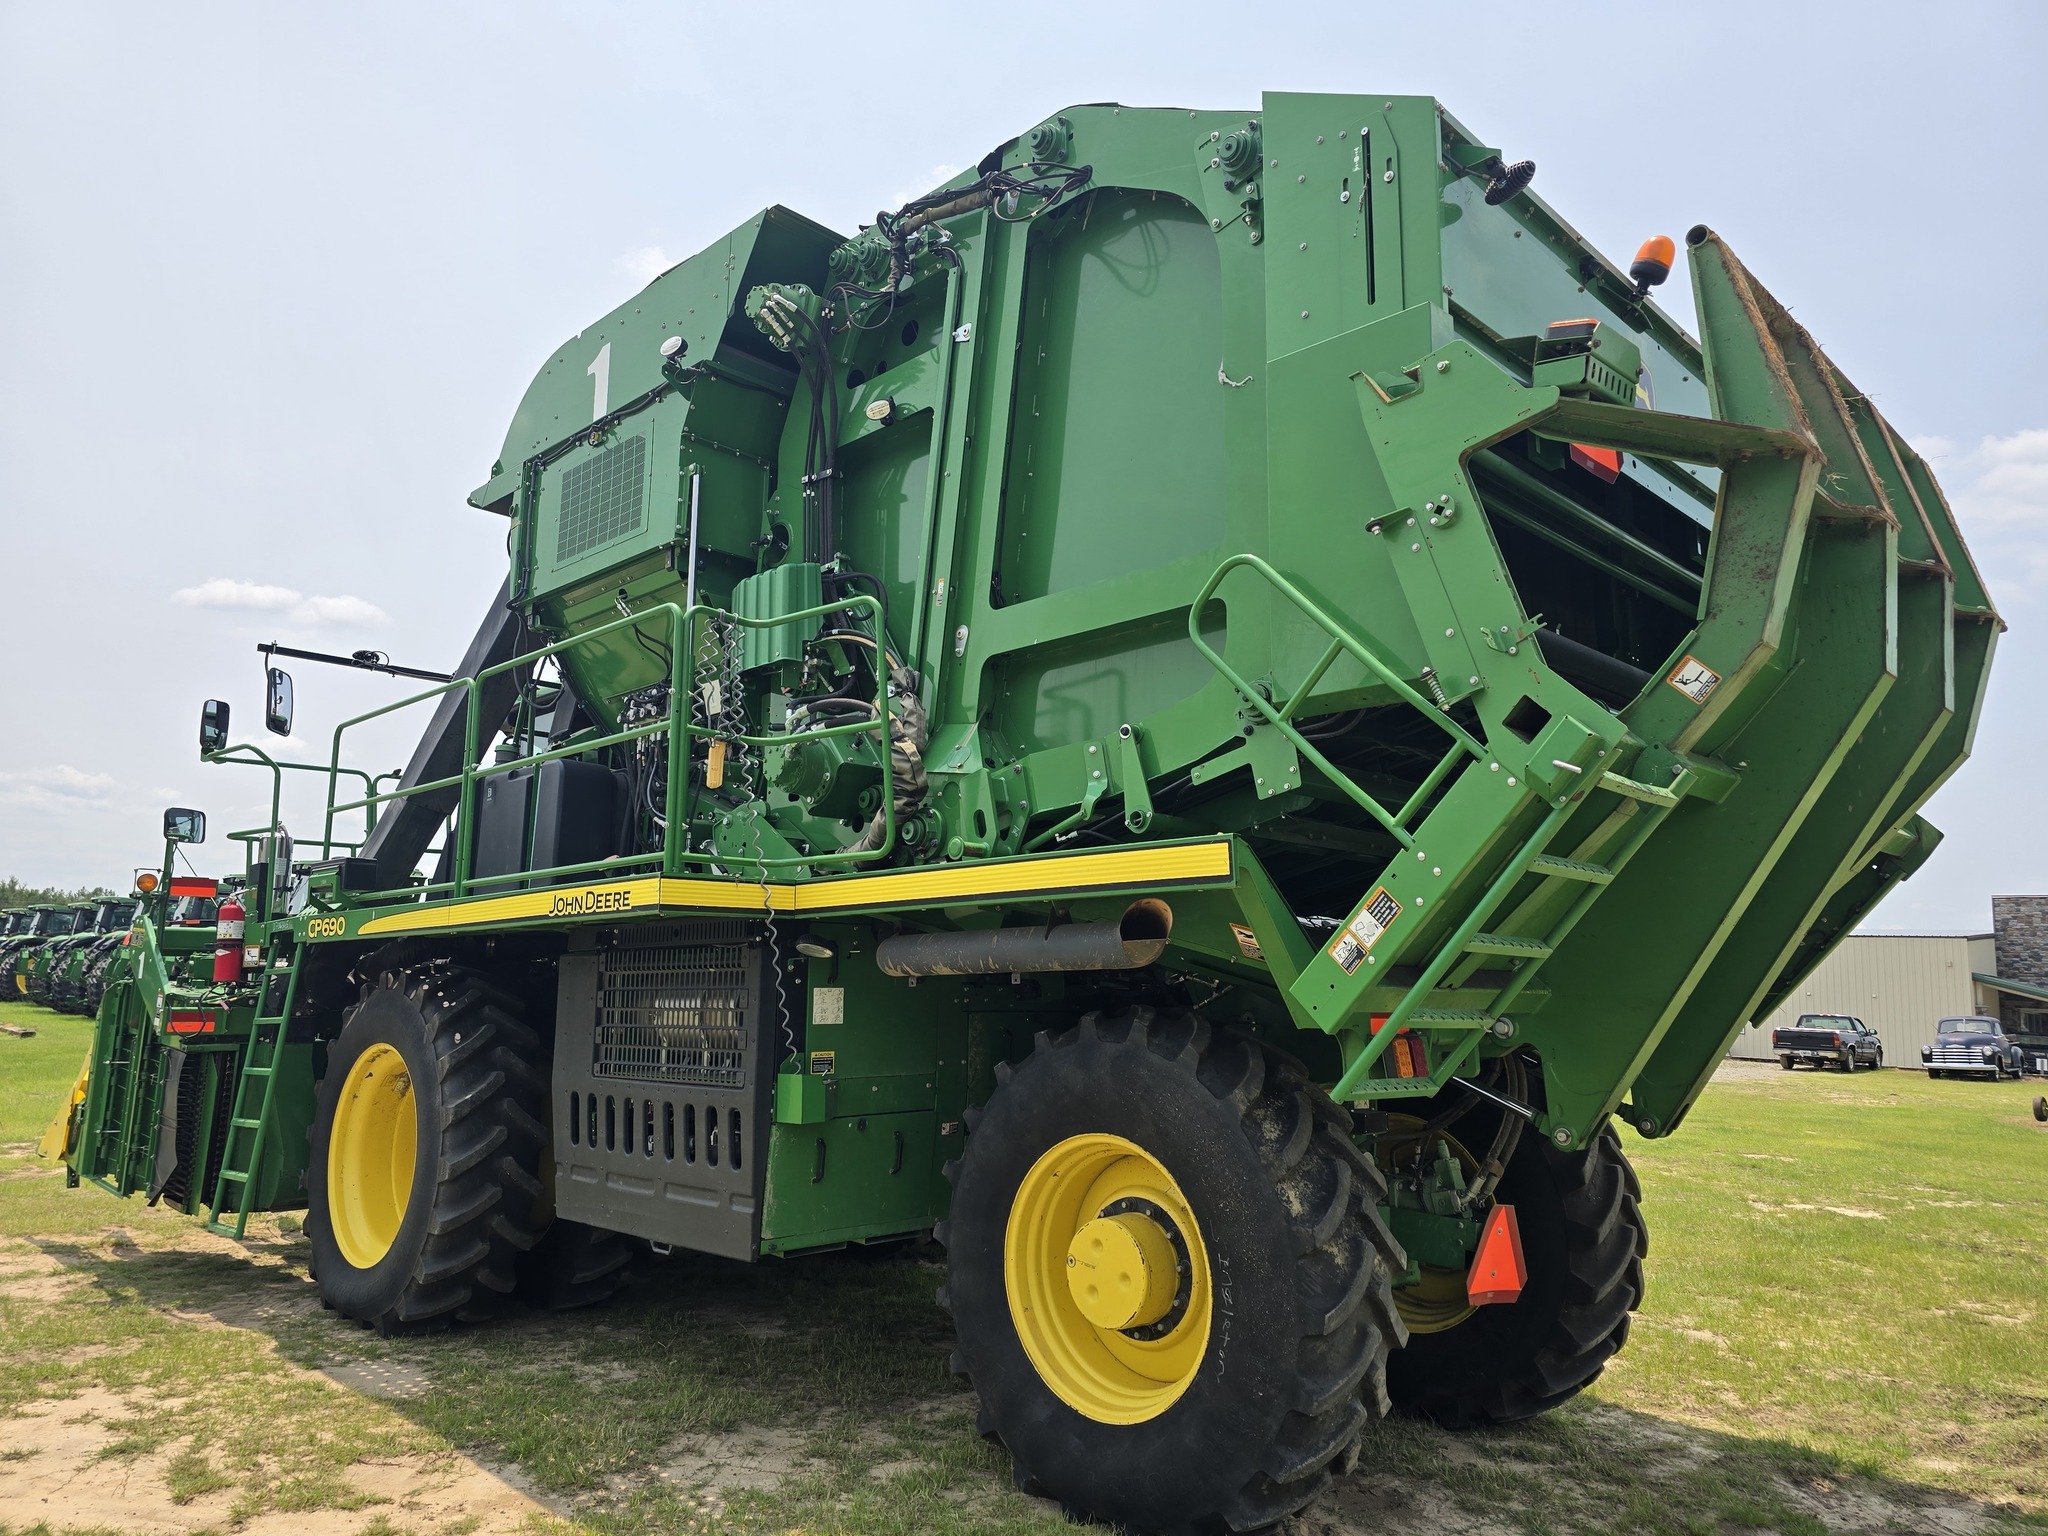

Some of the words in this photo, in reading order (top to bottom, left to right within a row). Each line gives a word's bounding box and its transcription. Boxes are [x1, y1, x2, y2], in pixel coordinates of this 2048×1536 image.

[587, 342, 611, 422] 1
[548, 894, 584, 915] JOHN
[585, 890, 631, 911] DEERE
[307, 915, 346, 939] CP690
[137, 951, 146, 980] 1
